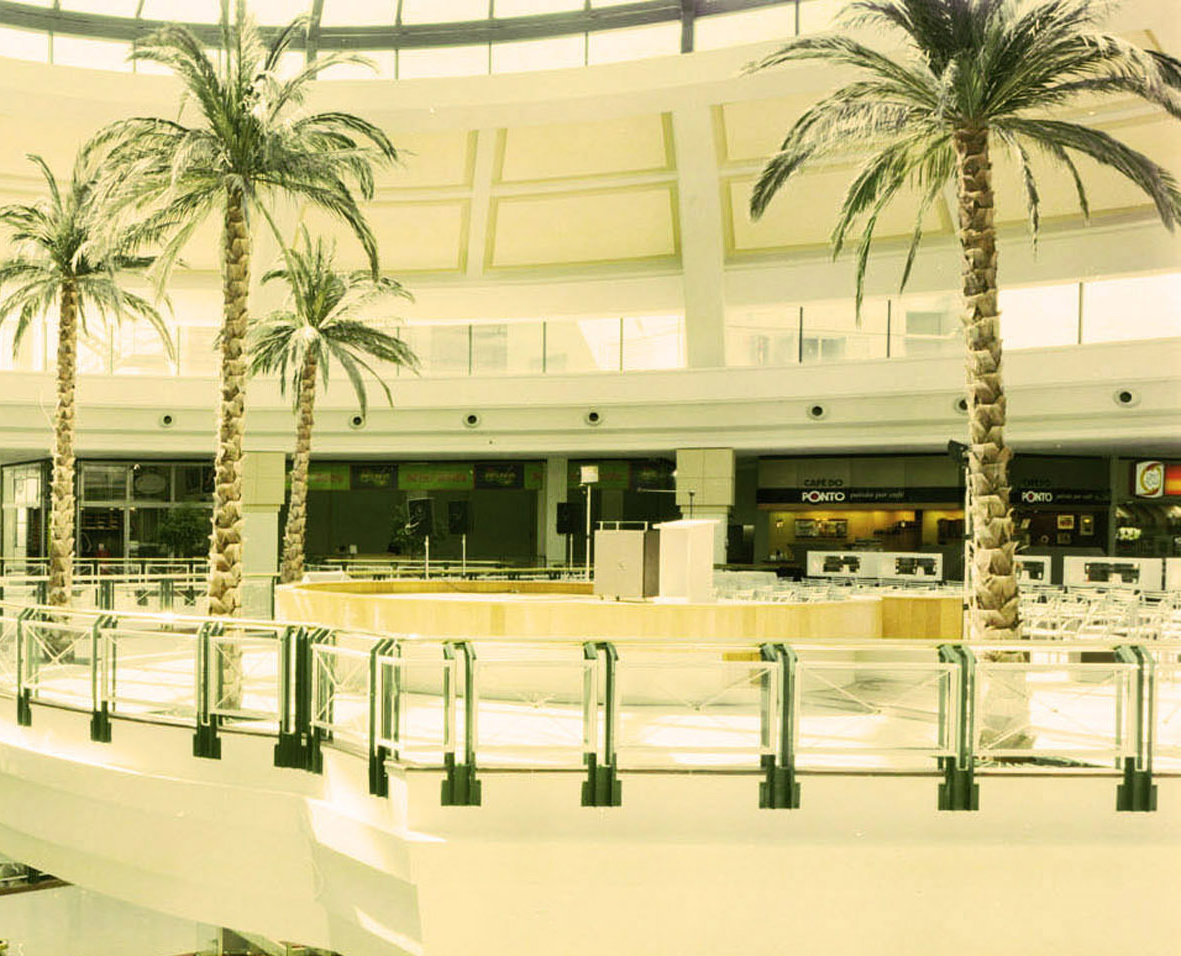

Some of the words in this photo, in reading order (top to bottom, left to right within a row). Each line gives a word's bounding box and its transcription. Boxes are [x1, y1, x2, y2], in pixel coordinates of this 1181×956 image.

[828, 479, 843, 487] DO
[802, 491, 846, 503] PONTO
[1022, 490, 1053, 503] PONTO
